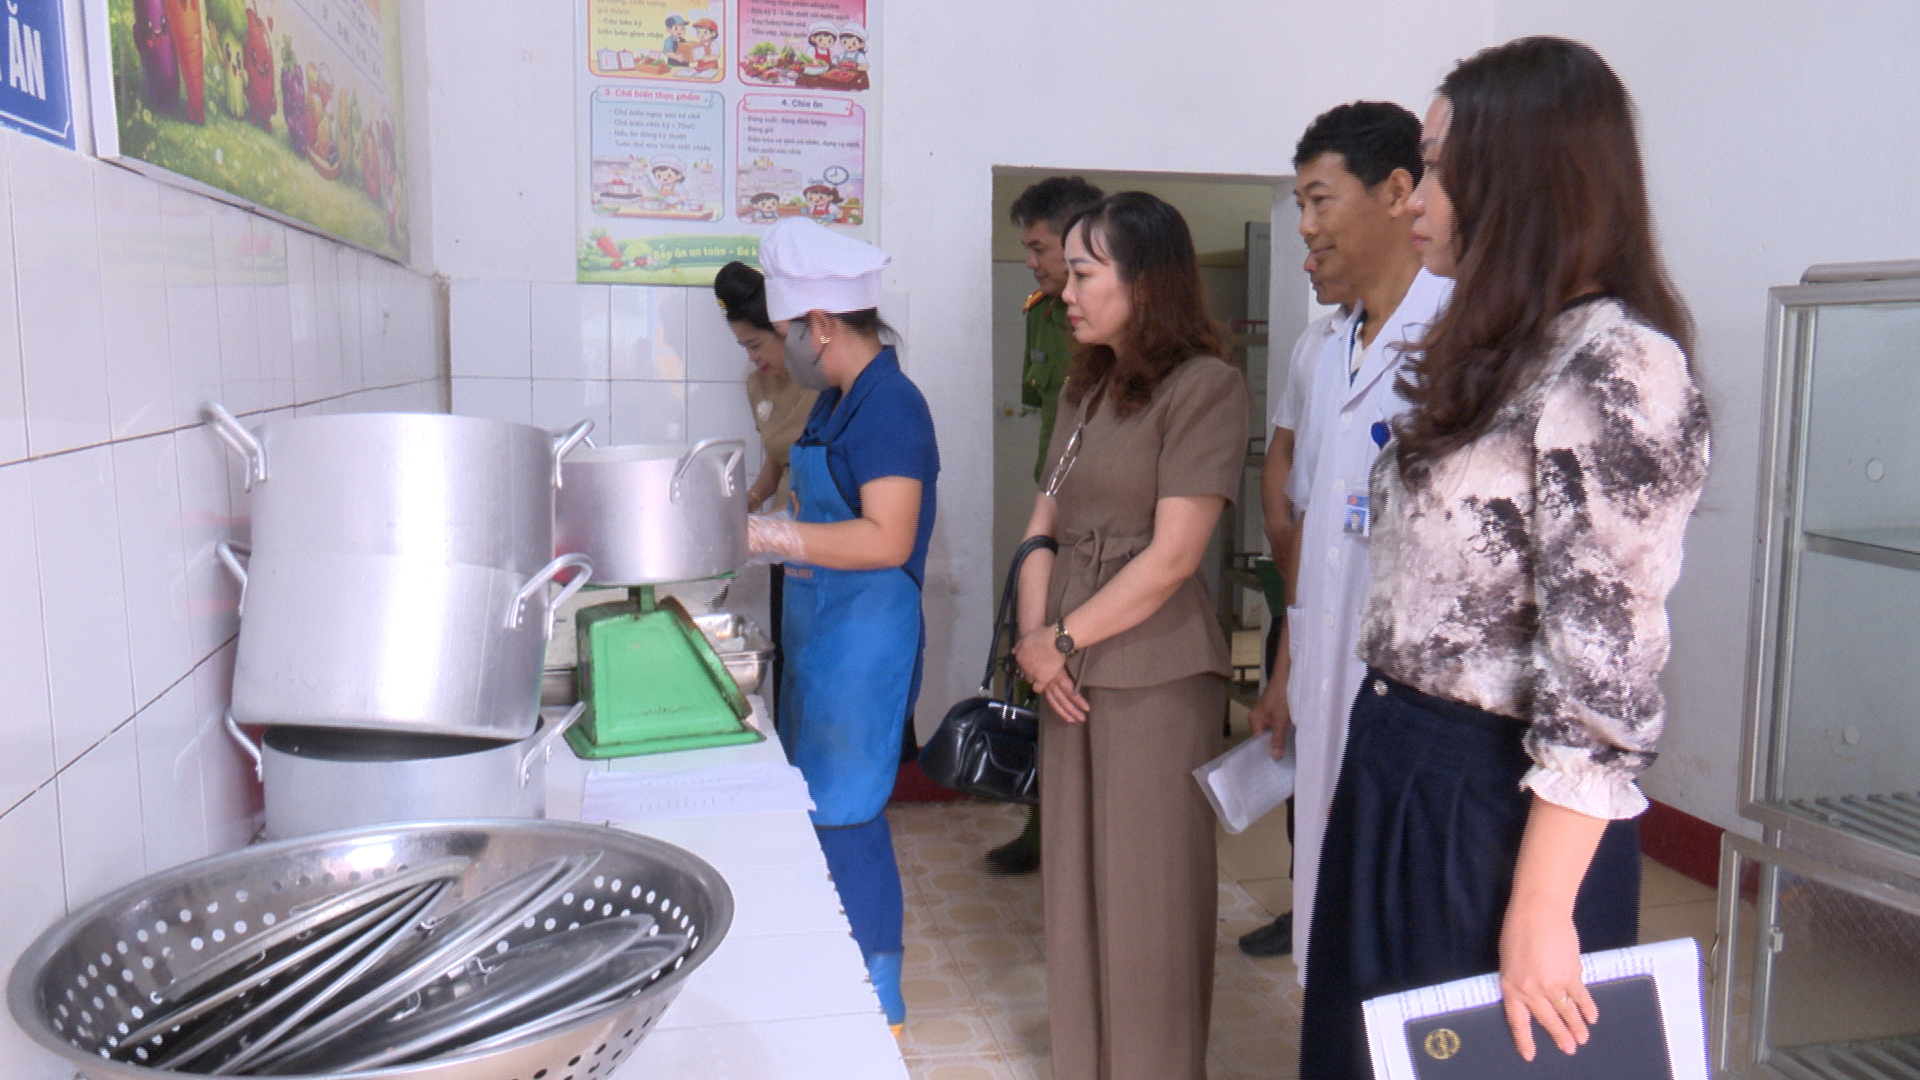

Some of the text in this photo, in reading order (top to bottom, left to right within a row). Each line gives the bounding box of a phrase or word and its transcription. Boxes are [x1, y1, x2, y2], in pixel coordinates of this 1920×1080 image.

[6, 0, 46, 101] ĂN
[614, 88, 633, 98] Chế
[634, 89, 653, 99] biến
[655, 90, 674, 100] thực
[675, 90, 701, 102] phẩm
[791, 99, 812, 108] Chia
[812, 99, 824, 108] ăn
